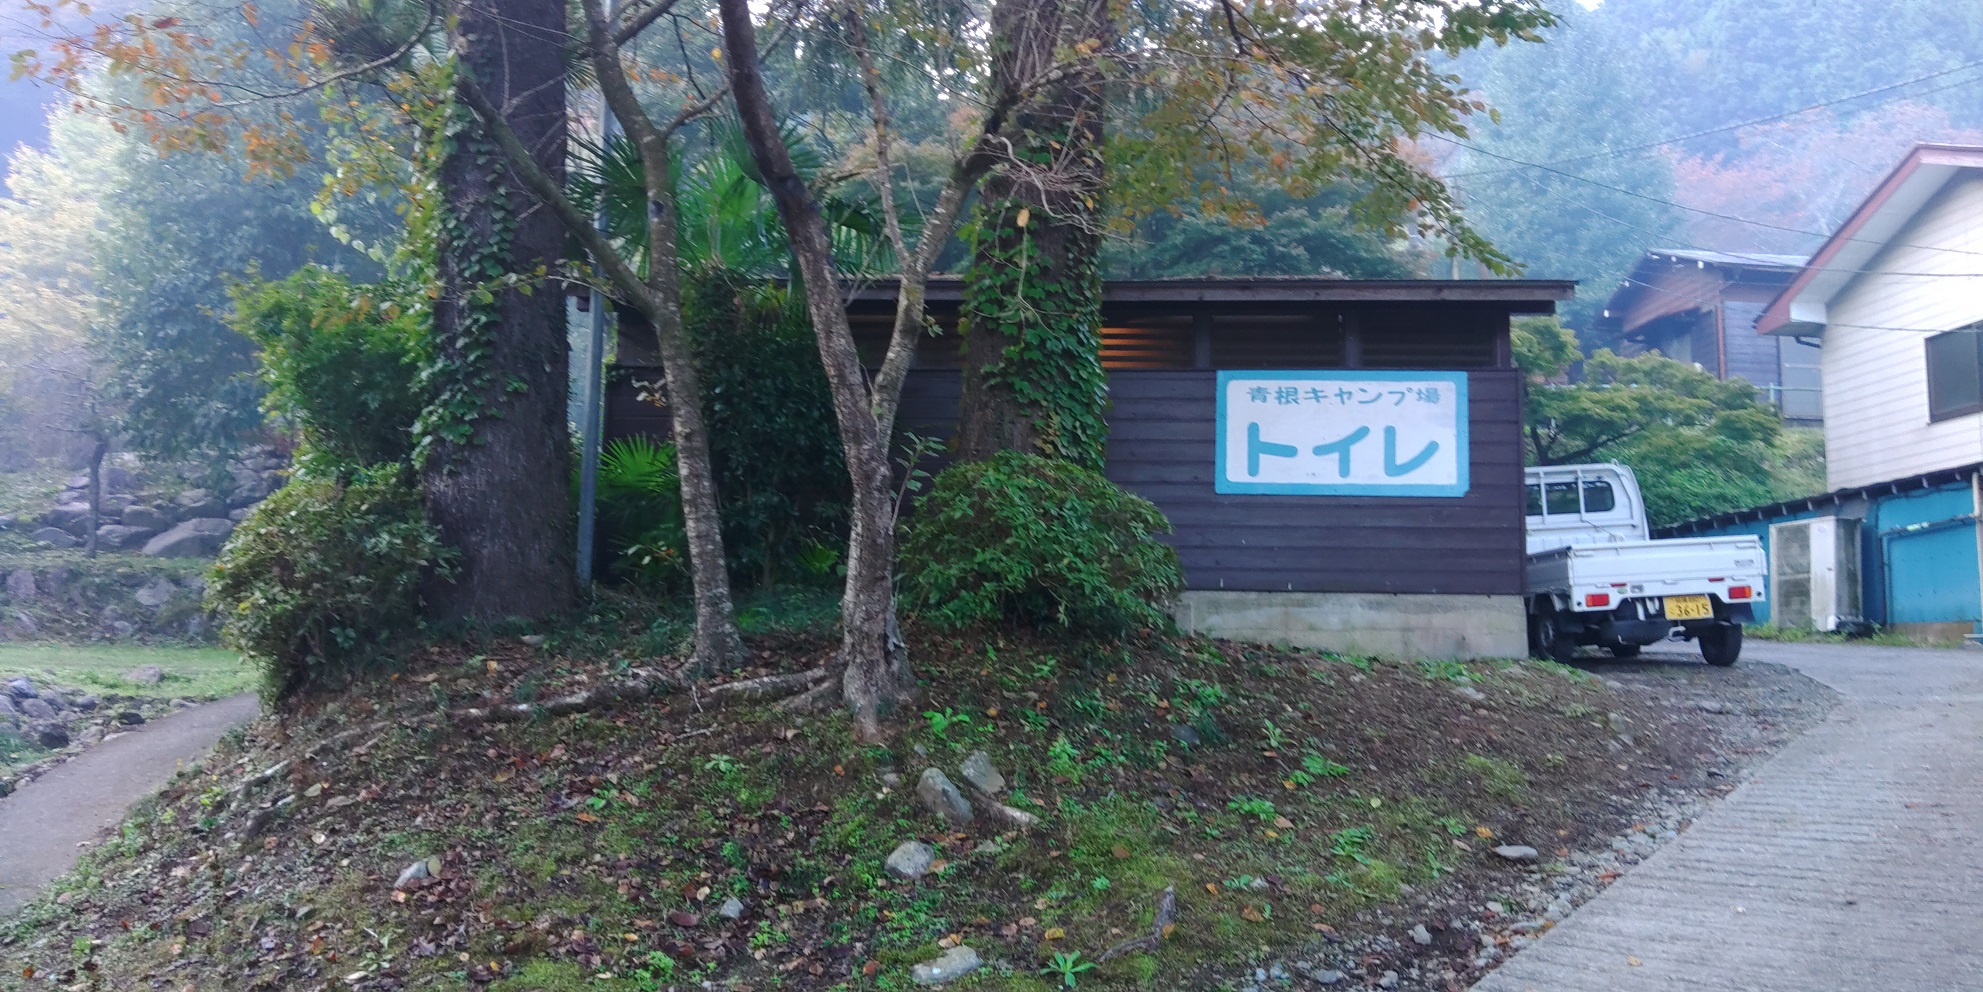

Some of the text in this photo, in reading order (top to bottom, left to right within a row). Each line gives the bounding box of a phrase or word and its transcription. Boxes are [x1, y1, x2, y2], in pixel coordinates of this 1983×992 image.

[1246, 386, 1441, 406] 青根キャンプ場
[1247, 422, 1440, 478] トイレ
[1676, 603, 1710, 617] 36-15
